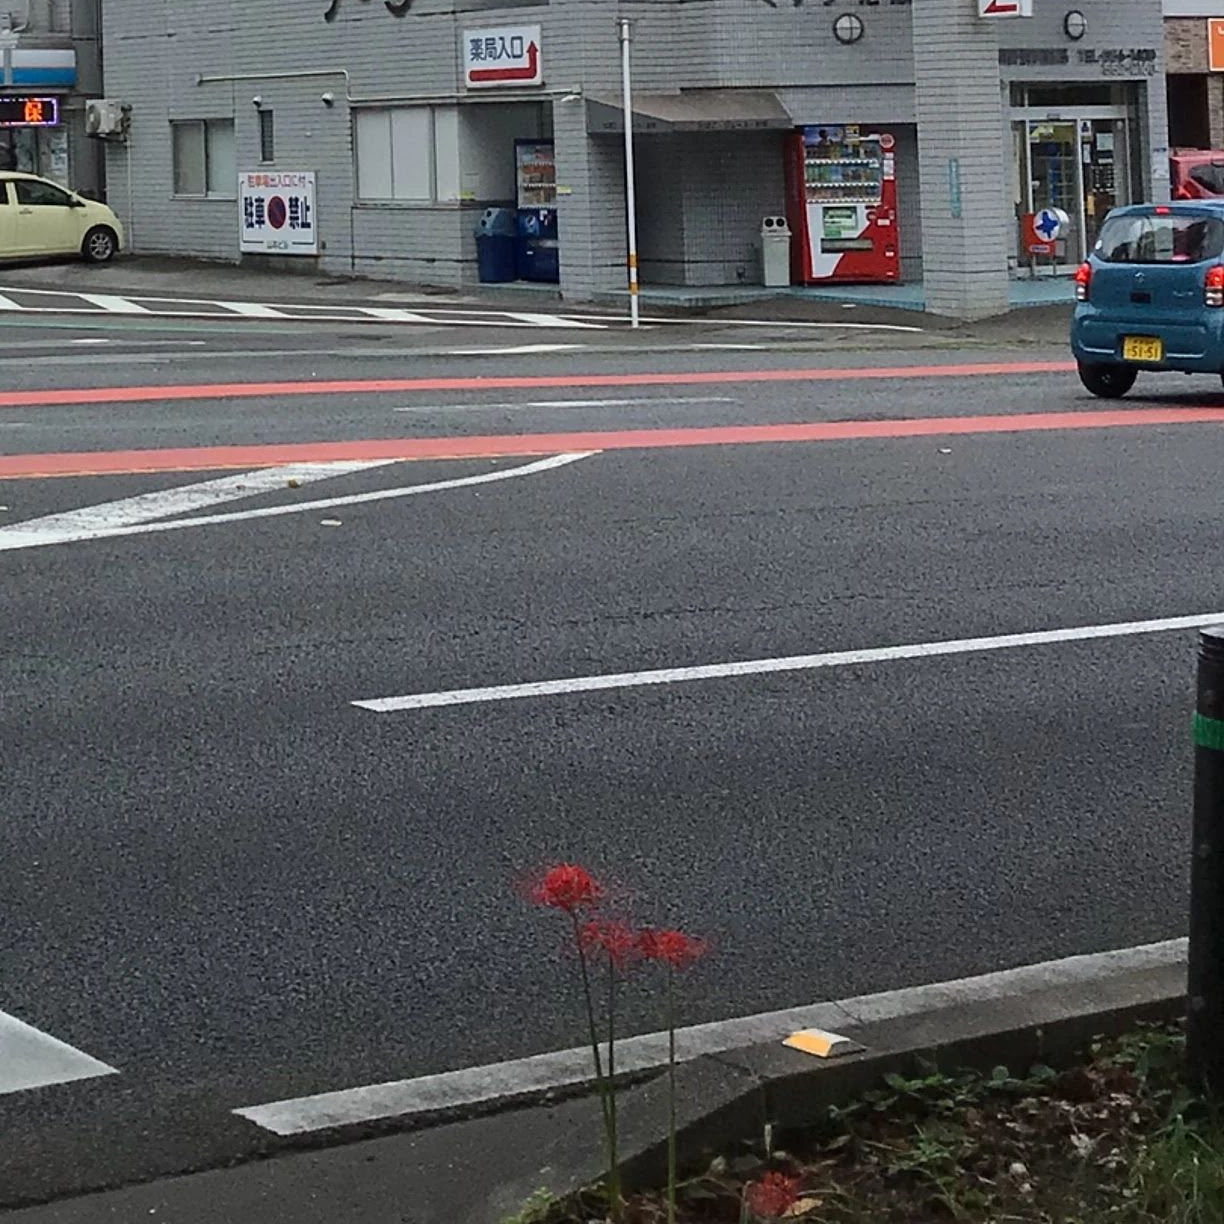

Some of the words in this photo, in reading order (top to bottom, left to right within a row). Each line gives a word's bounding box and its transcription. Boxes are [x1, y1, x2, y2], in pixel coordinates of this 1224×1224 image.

[470, 35, 524, 61] 薬局入口
[24, 101, 44, 122] 保
[244, 195, 265, 229] 駐車
[288, 195, 312, 230] 禁止
